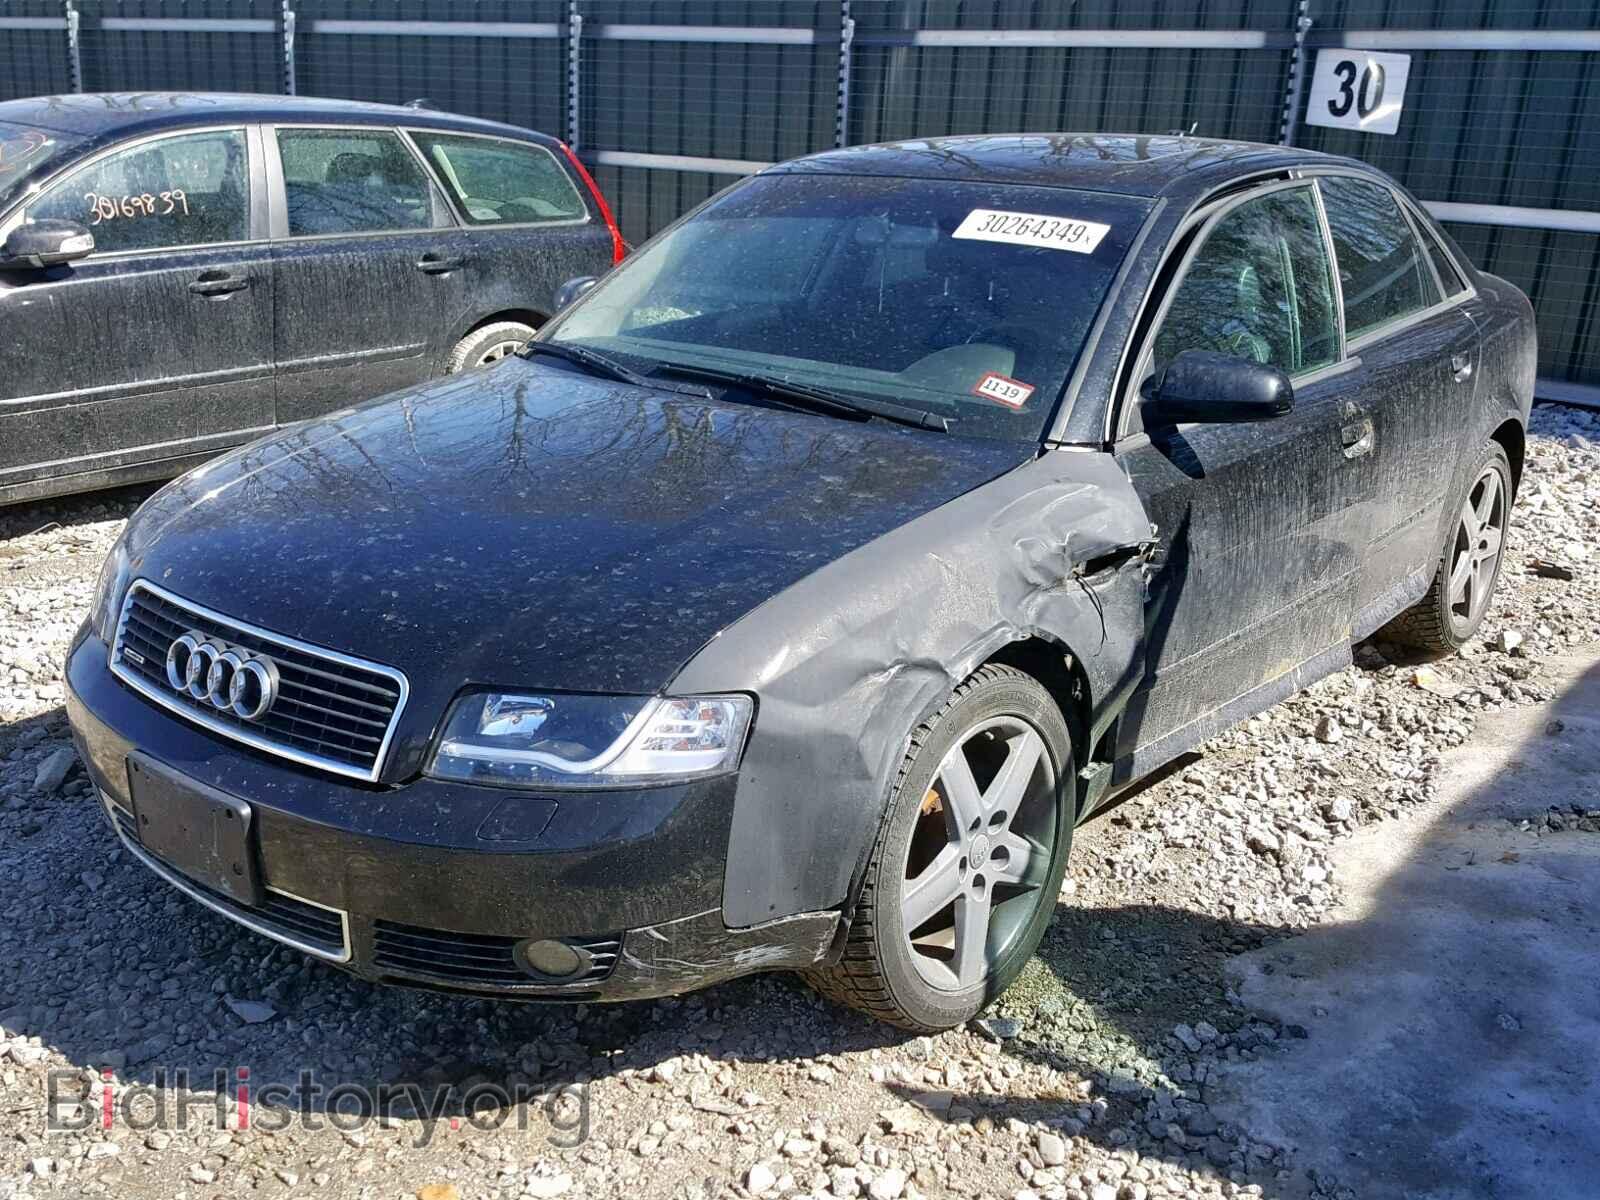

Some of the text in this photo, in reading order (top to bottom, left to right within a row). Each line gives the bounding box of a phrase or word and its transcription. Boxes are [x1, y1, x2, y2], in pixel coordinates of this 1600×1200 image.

[1327, 60, 1385, 119] 30
[976, 214, 1088, 244] 30264349
[983, 379, 1020, 399] 11-19
